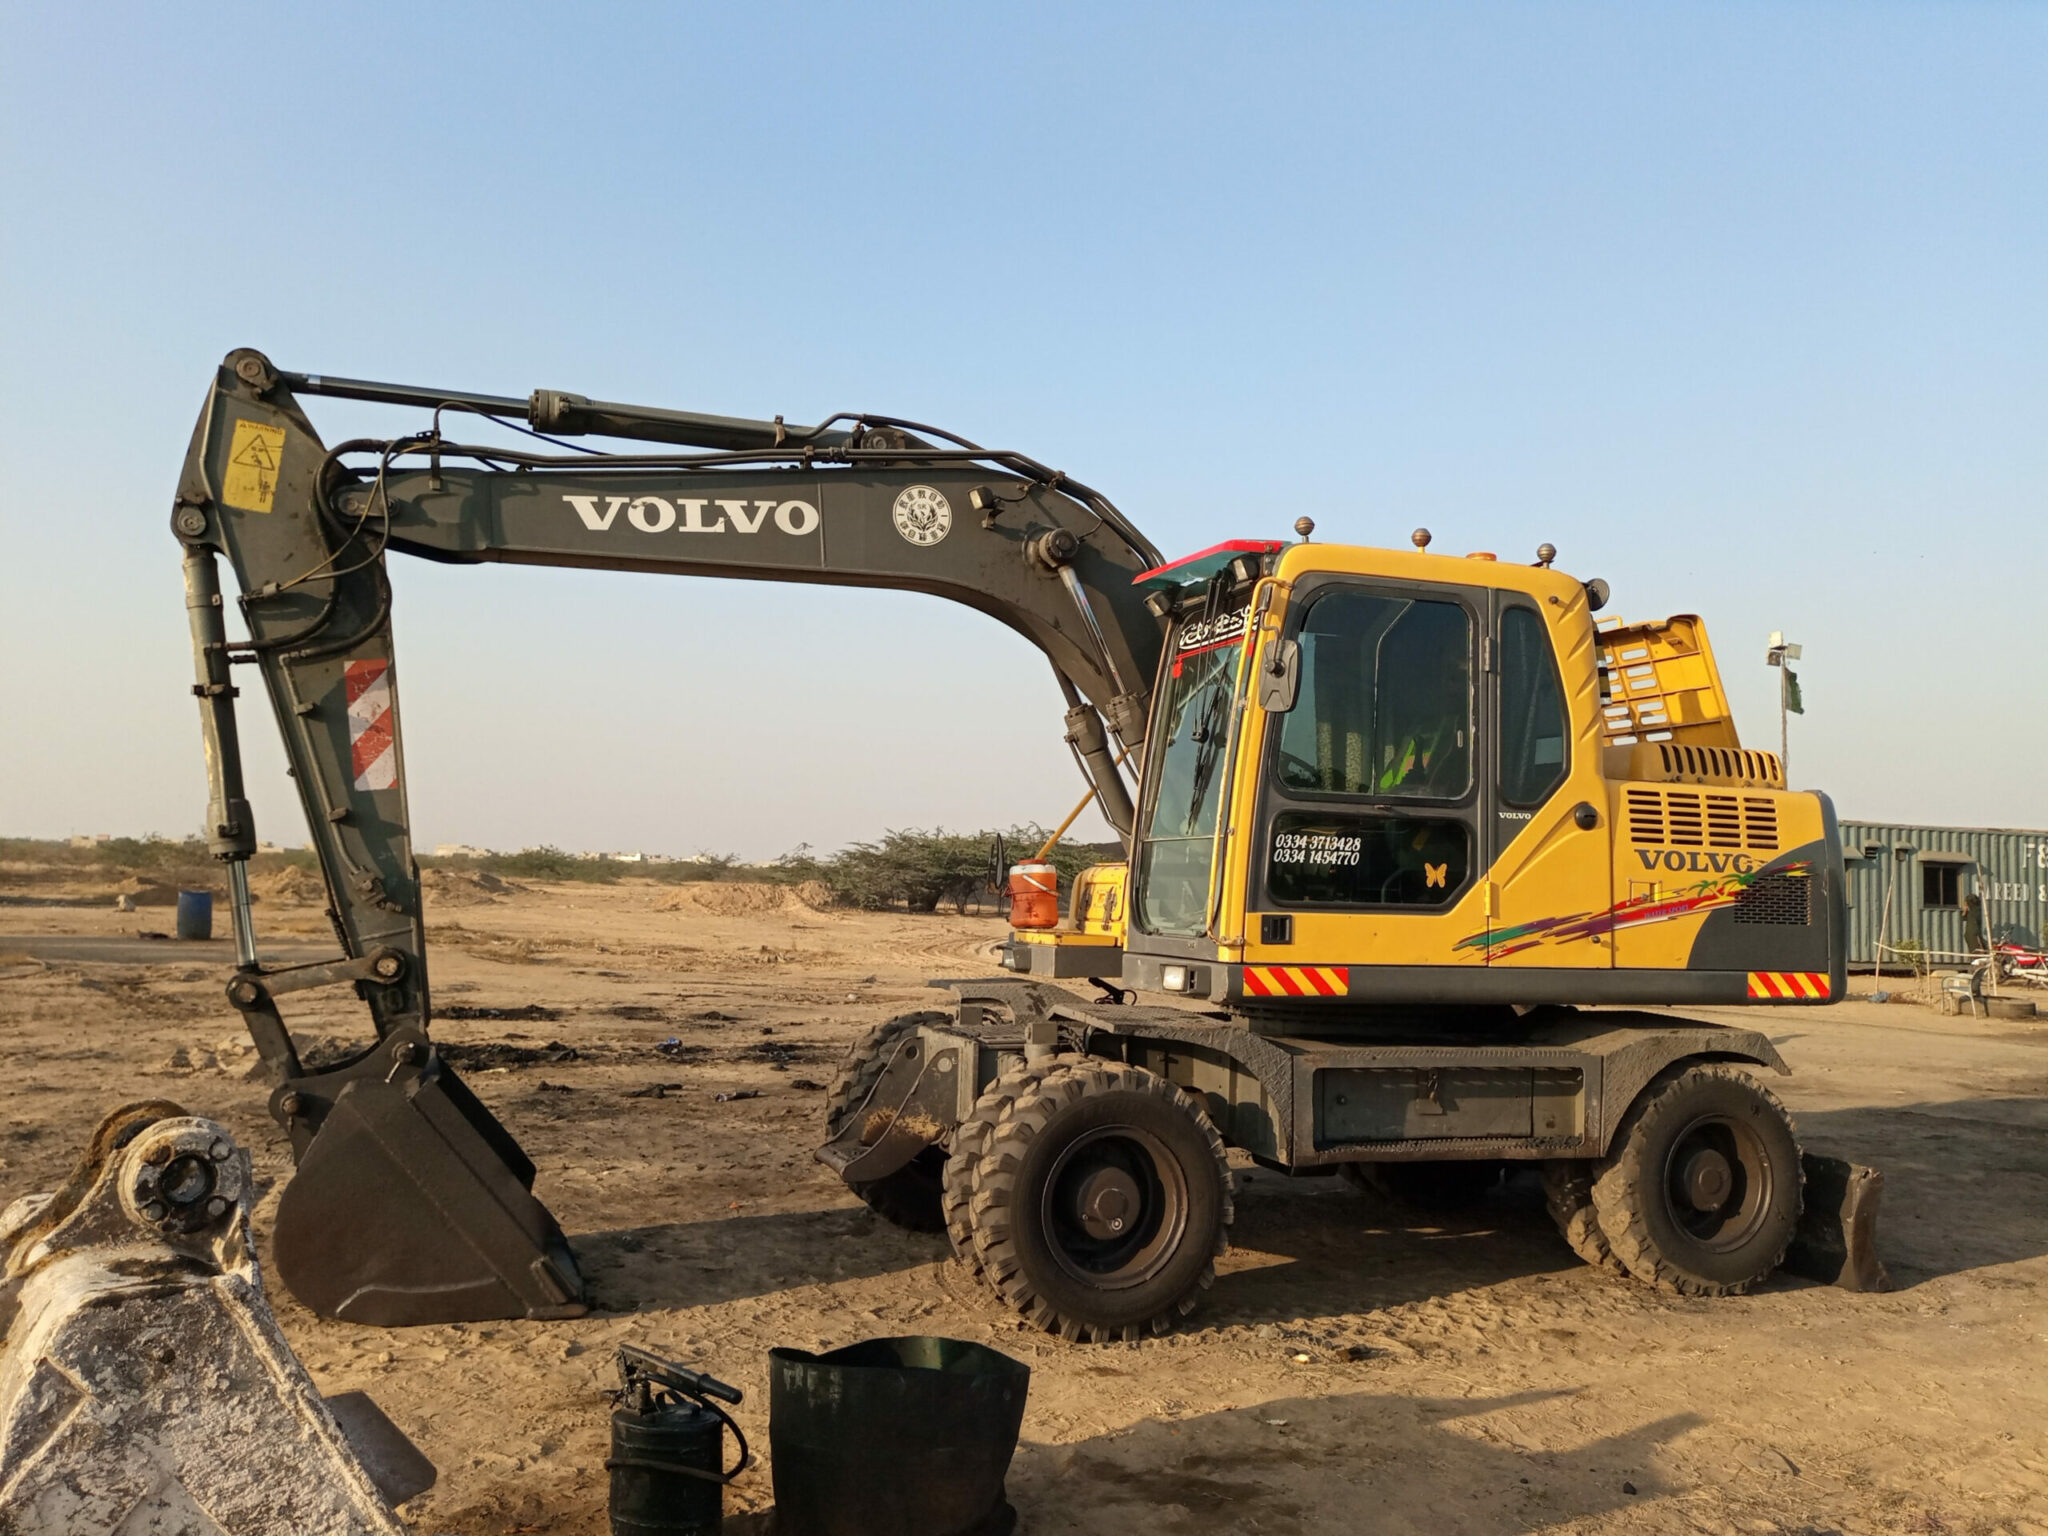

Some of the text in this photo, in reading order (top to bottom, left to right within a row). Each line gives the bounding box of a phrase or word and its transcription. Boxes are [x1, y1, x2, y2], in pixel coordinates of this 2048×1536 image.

[562, 495, 820, 536] VOLVO
[1498, 811, 1532, 820] VOLVO
[1275, 834, 1361, 851] 0334 3713428
[1273, 849, 1360, 866] 0334 1454770
[1635, 849, 1753, 874] VOLVO
